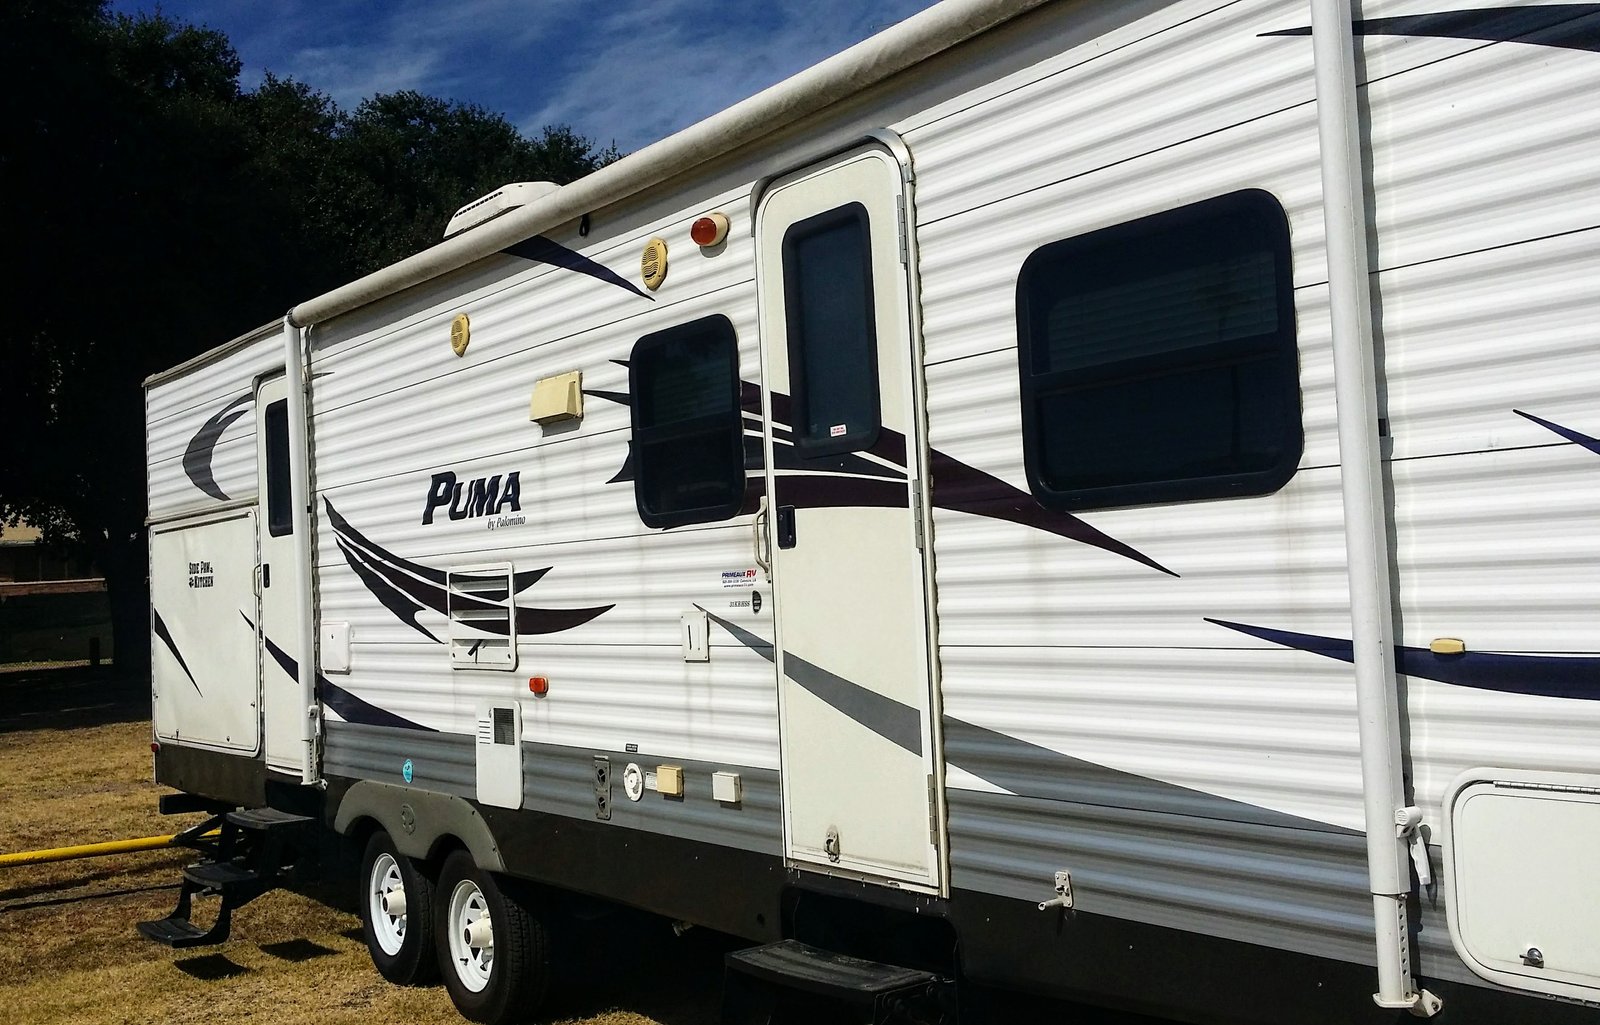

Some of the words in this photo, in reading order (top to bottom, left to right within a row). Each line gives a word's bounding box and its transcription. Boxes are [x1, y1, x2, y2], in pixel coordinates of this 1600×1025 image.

[422, 471, 521, 525] PUMA
[487, 518, 496, 530] by
[496, 514, 526, 528] Palomino
[189, 562, 199, 574] SIDE
[746, 570, 757, 578] RV
[194, 575, 214, 588] KITCHEN
